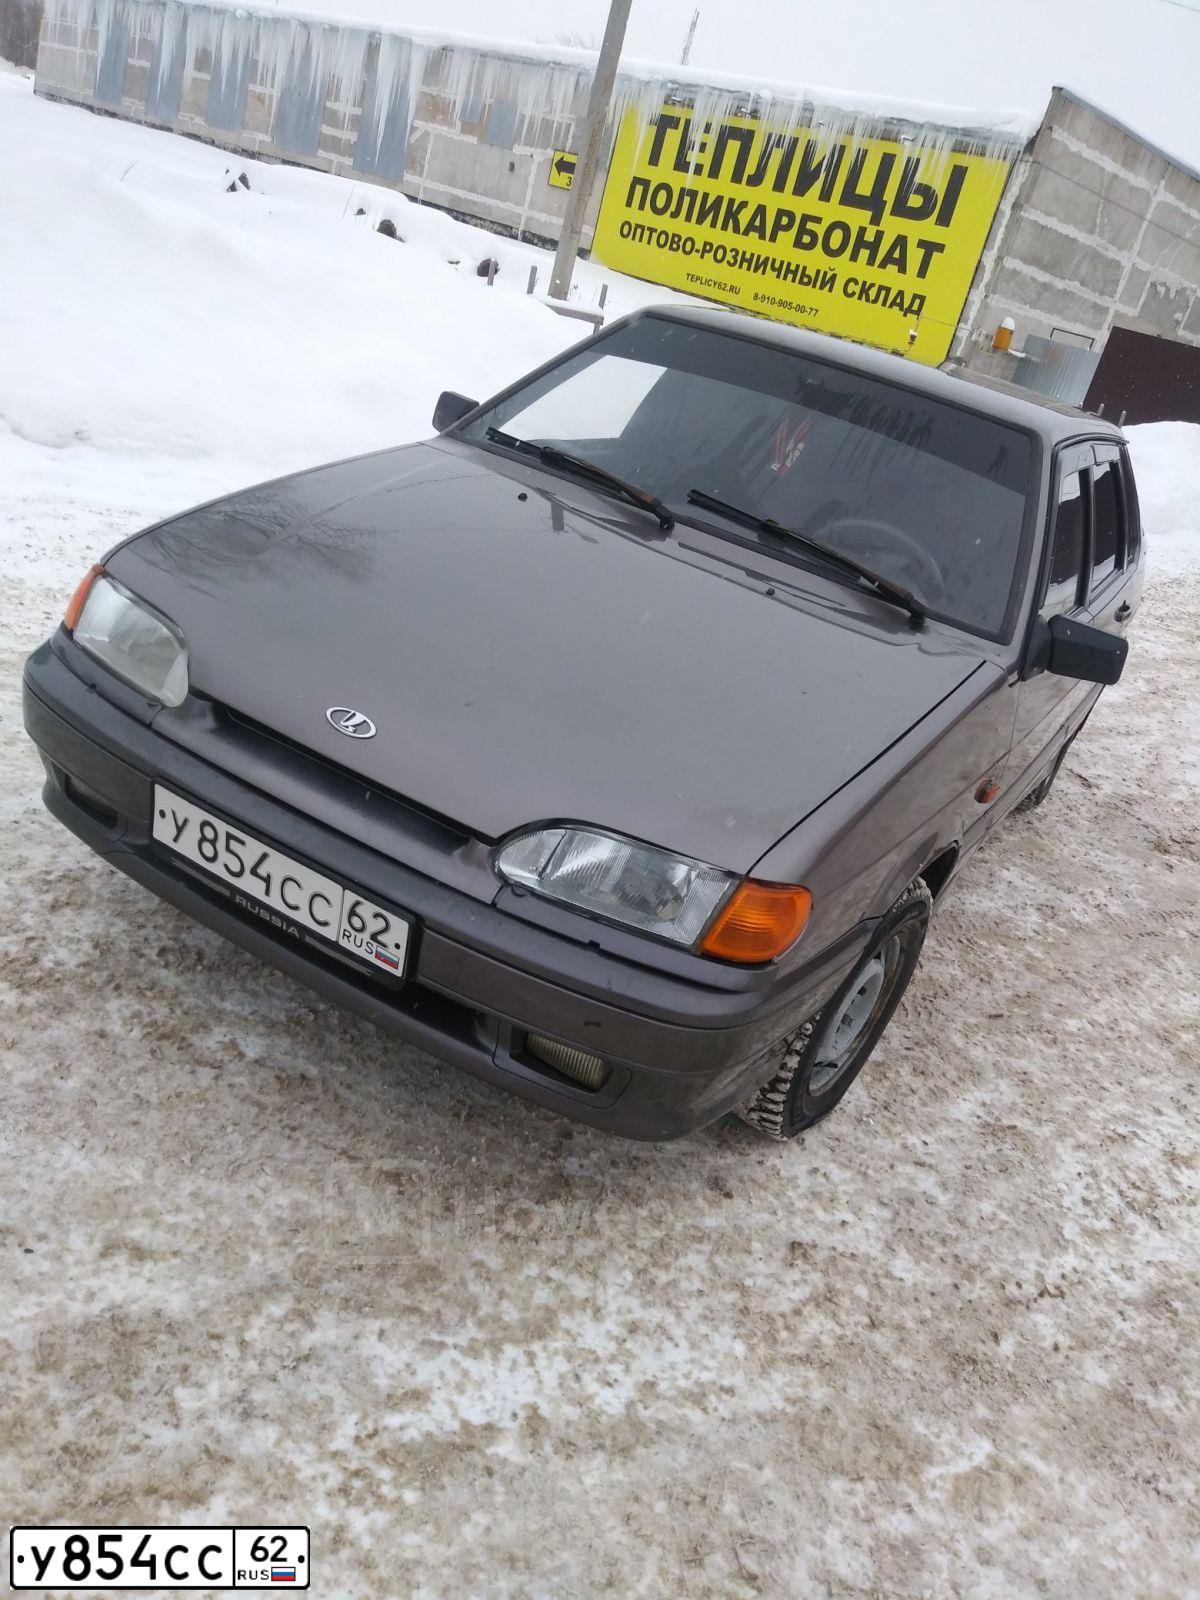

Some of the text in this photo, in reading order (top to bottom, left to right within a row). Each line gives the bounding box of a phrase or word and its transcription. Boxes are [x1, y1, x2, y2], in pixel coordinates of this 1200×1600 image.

[647, 114, 967, 227] ТЕПЛИЦЫ
[625, 176, 945, 278] ПОЛИКАРБОНАТ
[619, 220, 927, 318] ОПТОВО-РОЗНИЧНЫЙ СКЛАД
[685, 271, 819, 318] TEPLICY62.RU 8-910-905-00-77
[236, 895, 299, 937] RUSSIA
[347, 900, 391, 949] 62
[342, 929, 375, 955] RUS
